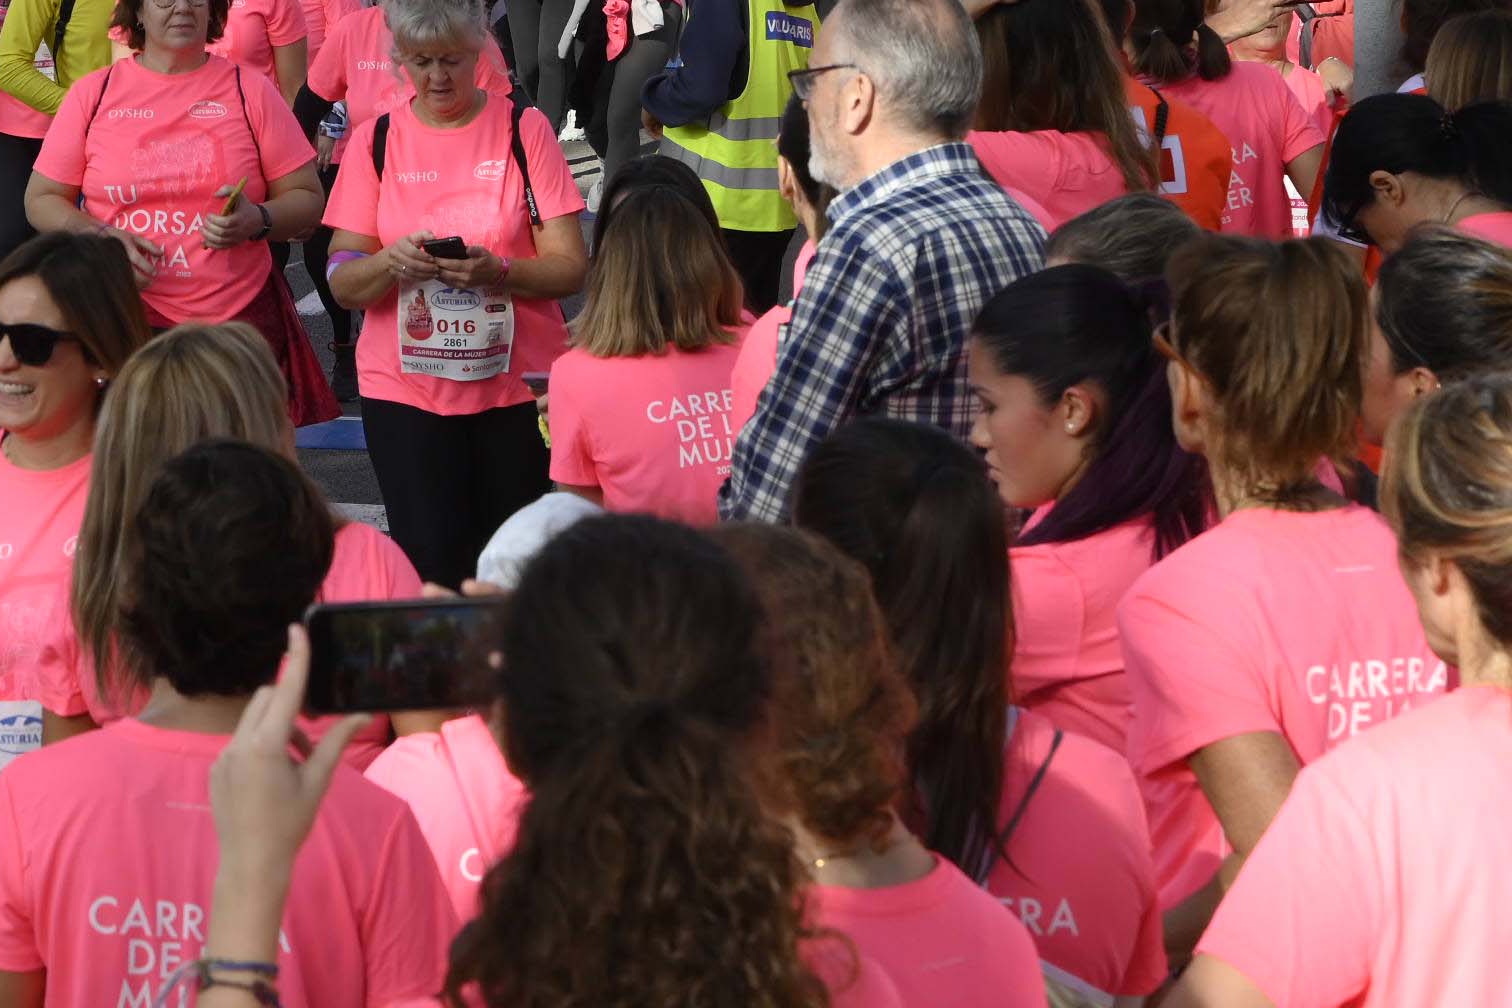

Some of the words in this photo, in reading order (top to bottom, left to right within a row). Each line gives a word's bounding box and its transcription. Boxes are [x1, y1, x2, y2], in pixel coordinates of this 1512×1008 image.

[108, 108, 154, 120] OYSHO
[104, 185, 137, 204] TU
[437, 319, 476, 334] 016
[444, 338, 468, 348] 2861
[413, 348, 443, 358] CARRERA
[678, 414, 713, 442] DE
[1306, 657, 1448, 705] CARRERA
